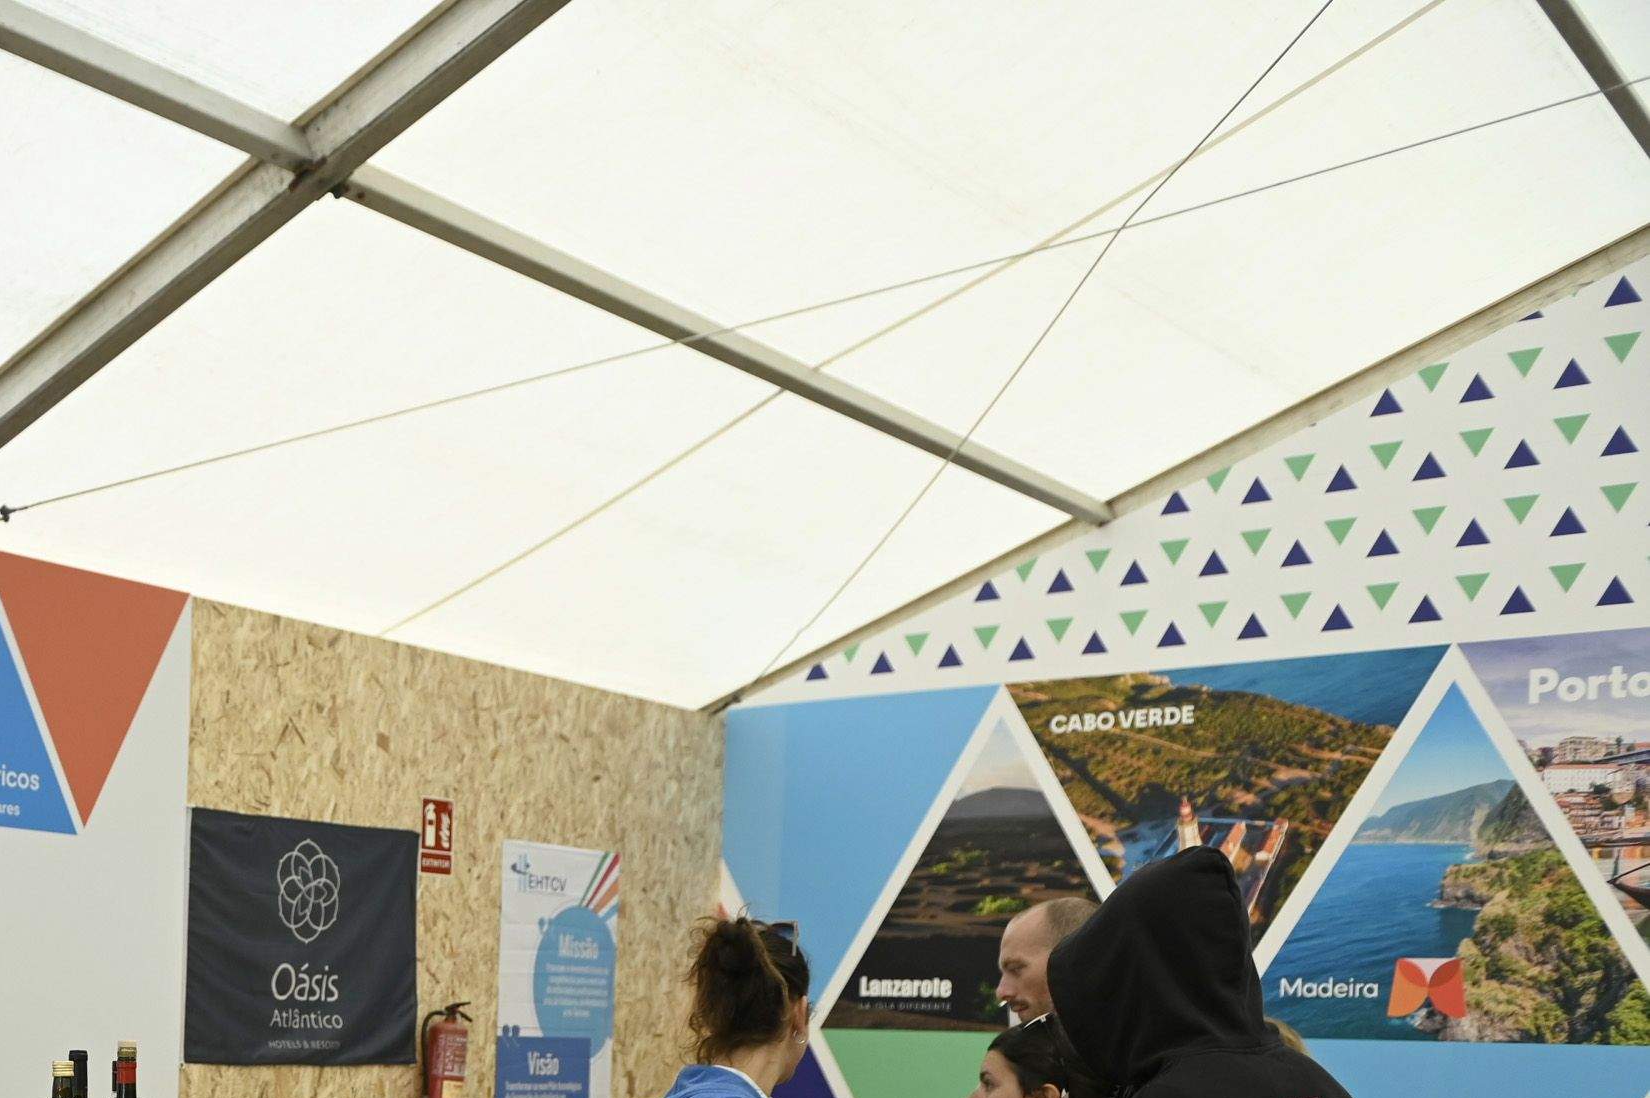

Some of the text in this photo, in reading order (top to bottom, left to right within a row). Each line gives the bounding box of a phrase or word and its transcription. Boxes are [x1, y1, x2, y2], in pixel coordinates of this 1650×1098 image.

[1529, 666, 1650, 704] Porto
[1050, 704, 1195, 735] CABO VERDE
[528, 873, 567, 892] EHTCV
[271, 962, 339, 1003] Oásis
[859, 975, 953, 999] Lanzarote
[1280, 976, 1379, 999] Madeira
[270, 1008, 344, 1030] Atlântico
[527, 1050, 559, 1076] Visão
